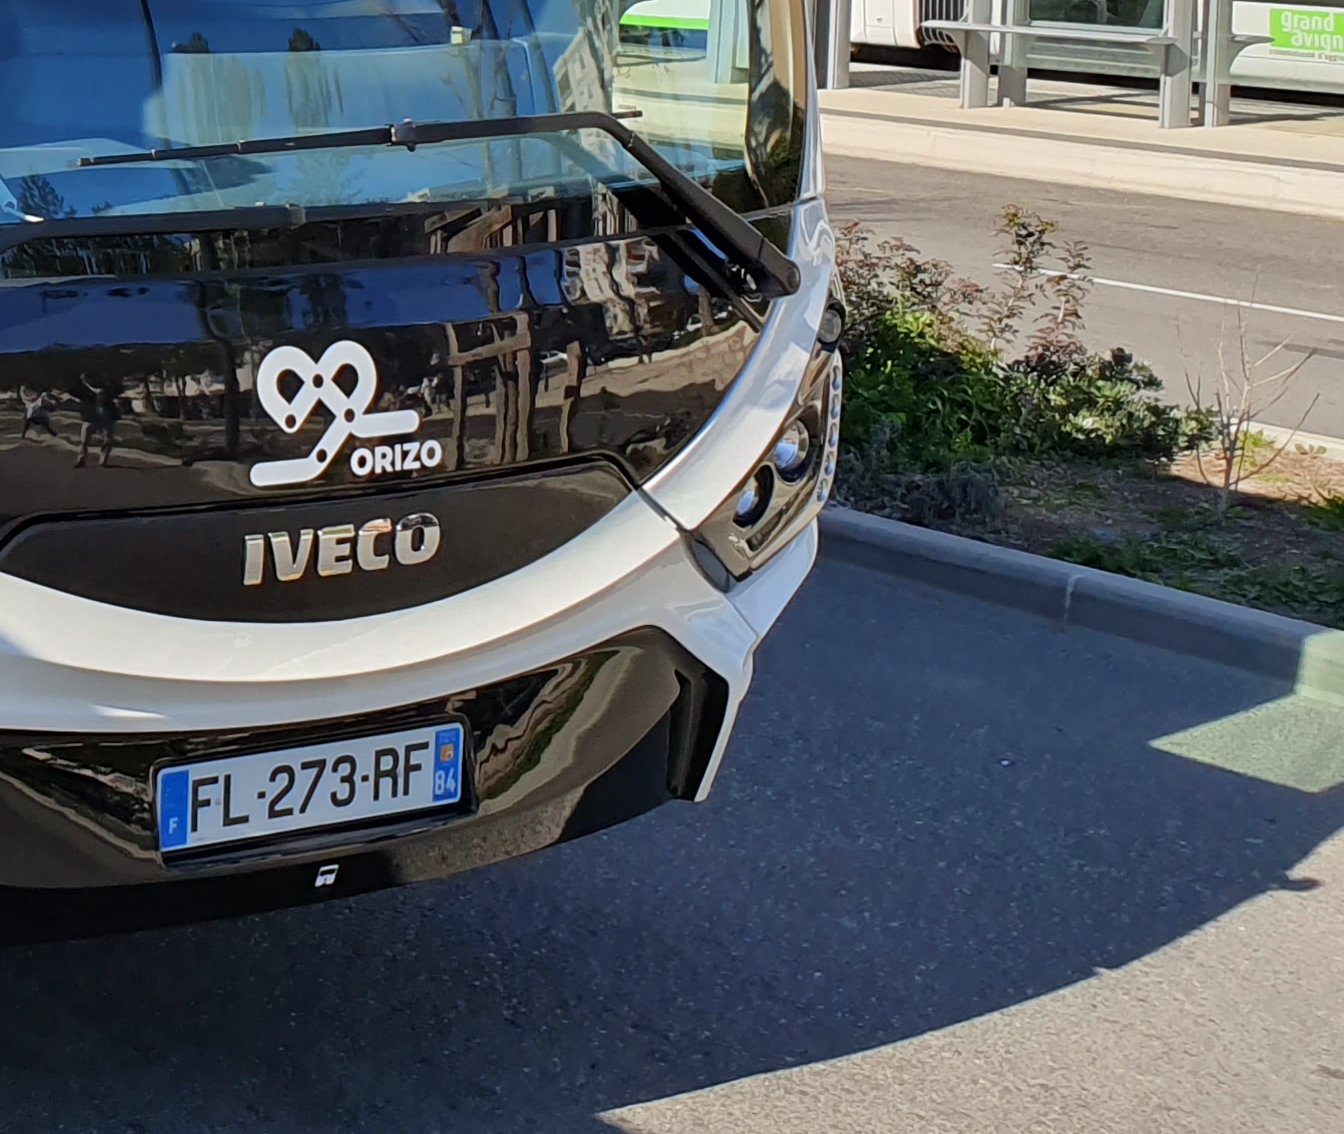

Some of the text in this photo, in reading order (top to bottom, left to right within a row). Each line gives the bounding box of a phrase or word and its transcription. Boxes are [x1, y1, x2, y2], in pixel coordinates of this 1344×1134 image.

[1280, 11, 1335, 33] grand
[350, 439, 443, 477] ORIZO
[243, 512, 441, 586] IVECO
[168, 741, 456, 835] F FL-273-RF 84
